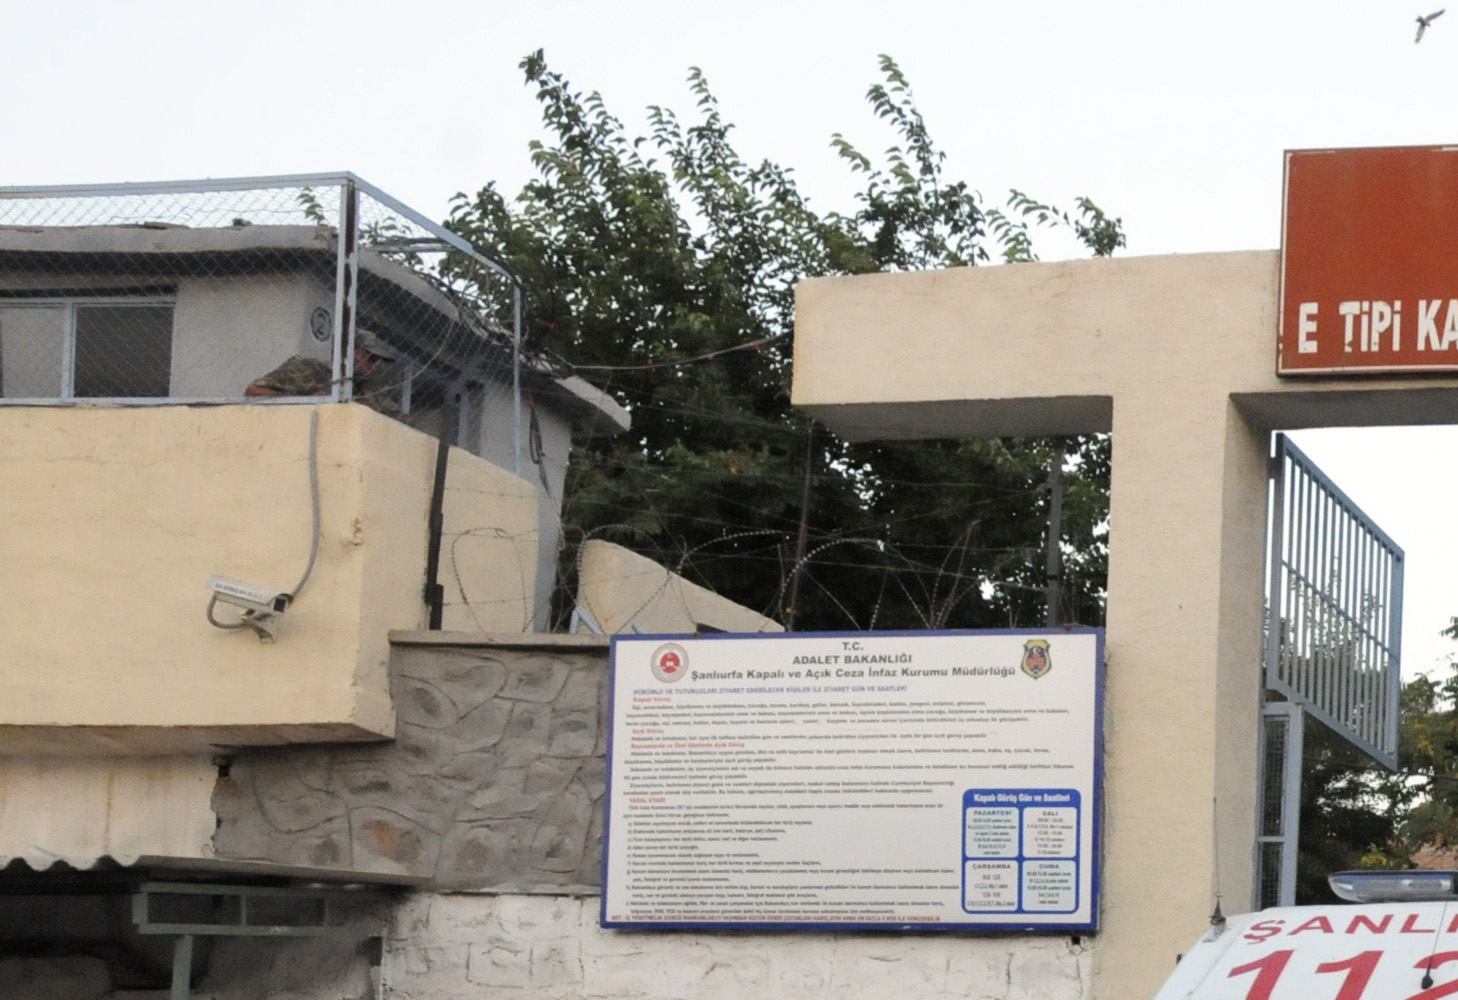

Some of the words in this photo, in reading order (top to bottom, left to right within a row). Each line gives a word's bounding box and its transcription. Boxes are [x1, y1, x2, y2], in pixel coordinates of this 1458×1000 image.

[1298, 302, 1318, 353] E
[842, 641, 865, 651] T.C.
[792, 655, 839, 665] ADALET
[844, 653, 912, 664] BAKANLIĞI
[746, 669, 784, 680] Kapalı
[788, 671, 801, 679] ve
[806, 668, 832, 680] Açık
[835, 668, 864, 678] Ceza
[868, 667, 897, 677] İnfaz
[901, 668, 948, 677] Kurumu
[952, 666, 1016, 677] Müdürlüğü
